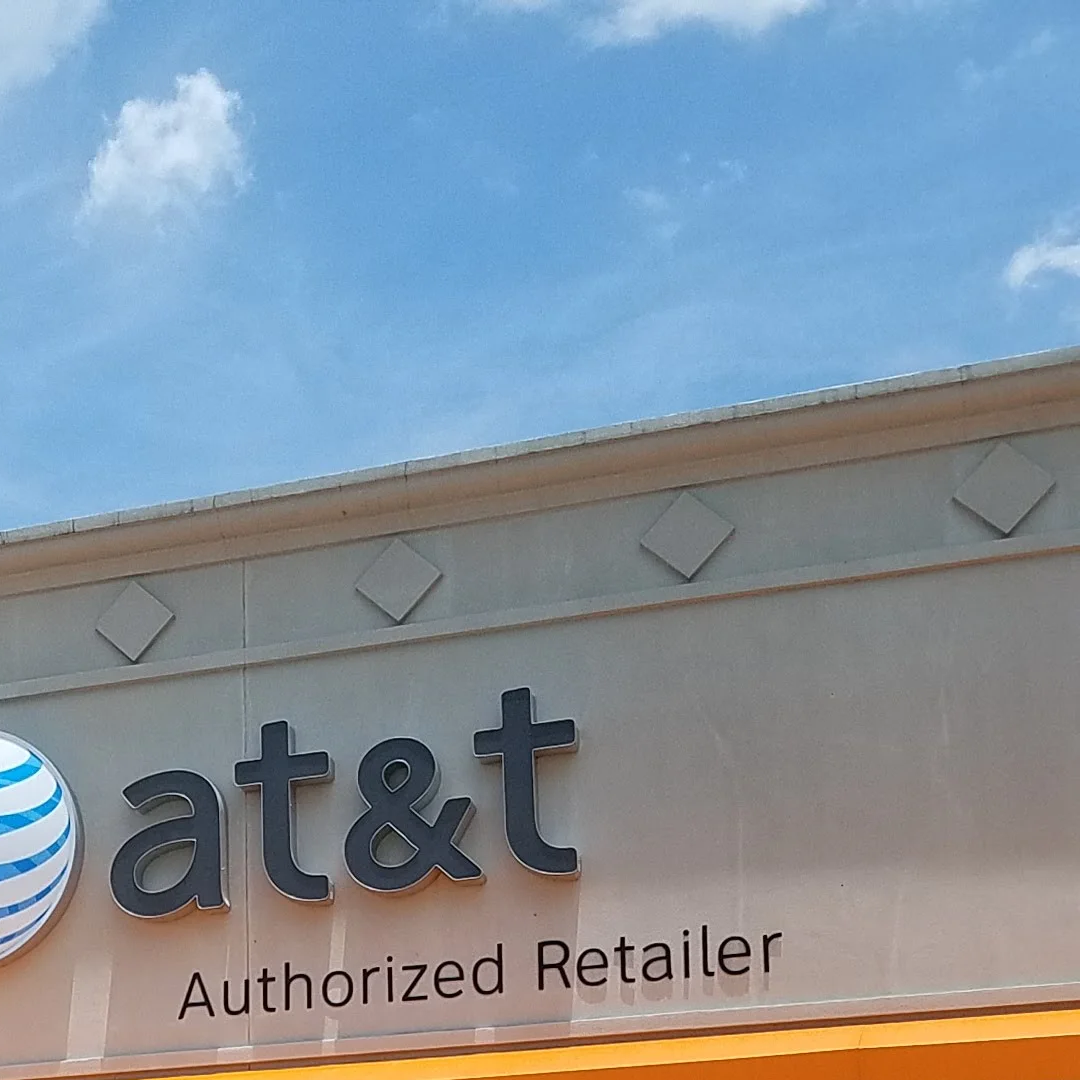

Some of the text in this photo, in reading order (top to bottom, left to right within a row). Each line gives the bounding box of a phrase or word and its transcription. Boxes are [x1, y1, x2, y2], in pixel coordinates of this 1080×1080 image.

[109, 686, 581, 920] at&t
[178, 924, 783, 1020] Authorized Retailer
